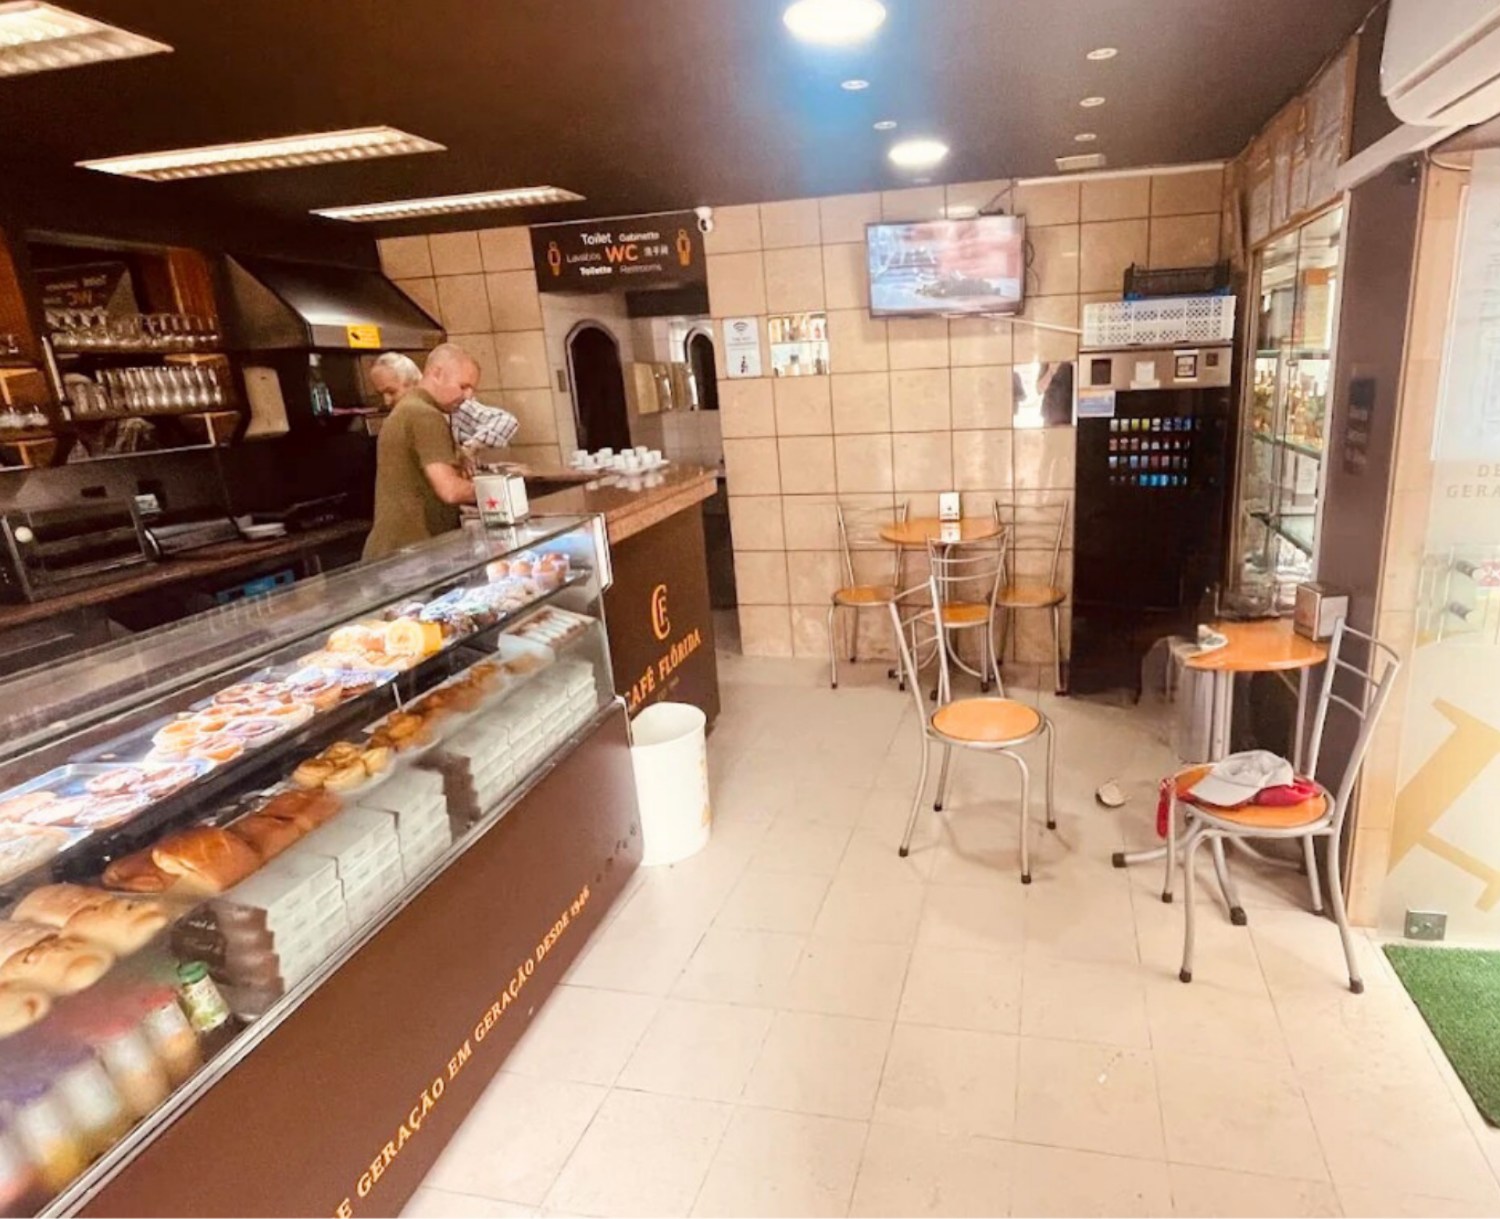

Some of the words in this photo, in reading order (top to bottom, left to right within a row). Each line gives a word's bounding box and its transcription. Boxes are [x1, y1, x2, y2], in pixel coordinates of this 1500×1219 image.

[580, 233, 612, 245] Toilet
[605, 244, 638, 263] WC
[658, 628, 701, 681] FLÓRIDA
[356, 1078, 446, 1199] GERAÇÃO
[447, 1040, 473, 1079] EM
[474, 959, 535, 1043] GERAÇÃO
[535, 913, 570, 962] DESDE
